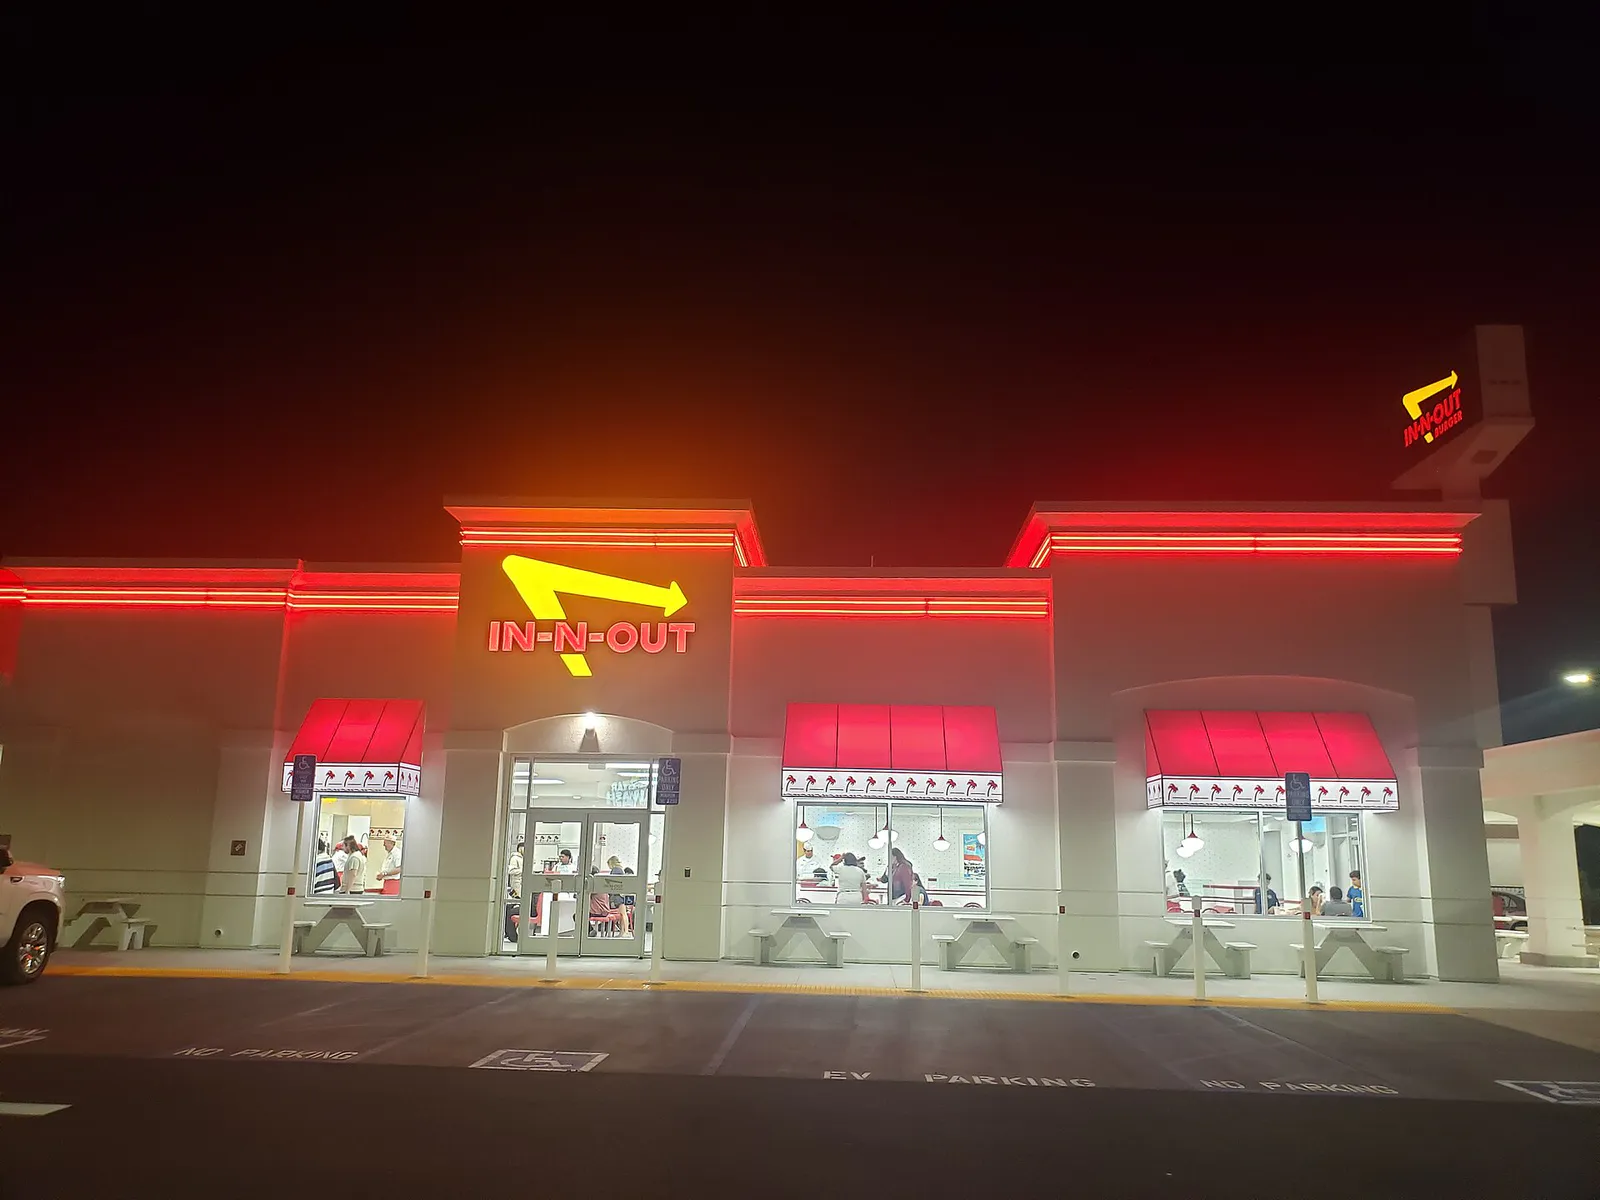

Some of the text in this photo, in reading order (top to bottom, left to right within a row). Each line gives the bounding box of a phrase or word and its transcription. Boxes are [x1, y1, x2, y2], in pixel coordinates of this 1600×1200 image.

[1403, 388, 1461, 447] IN-N-OUT
[1434, 410, 1463, 439] BURGER
[488, 620, 696, 653] IN-N-OUT
[173, 1047, 359, 1060] NO PARKING
[822, 1070, 1096, 1087] EV PARKING
[1200, 1079, 1399, 1095] NO PARKING
